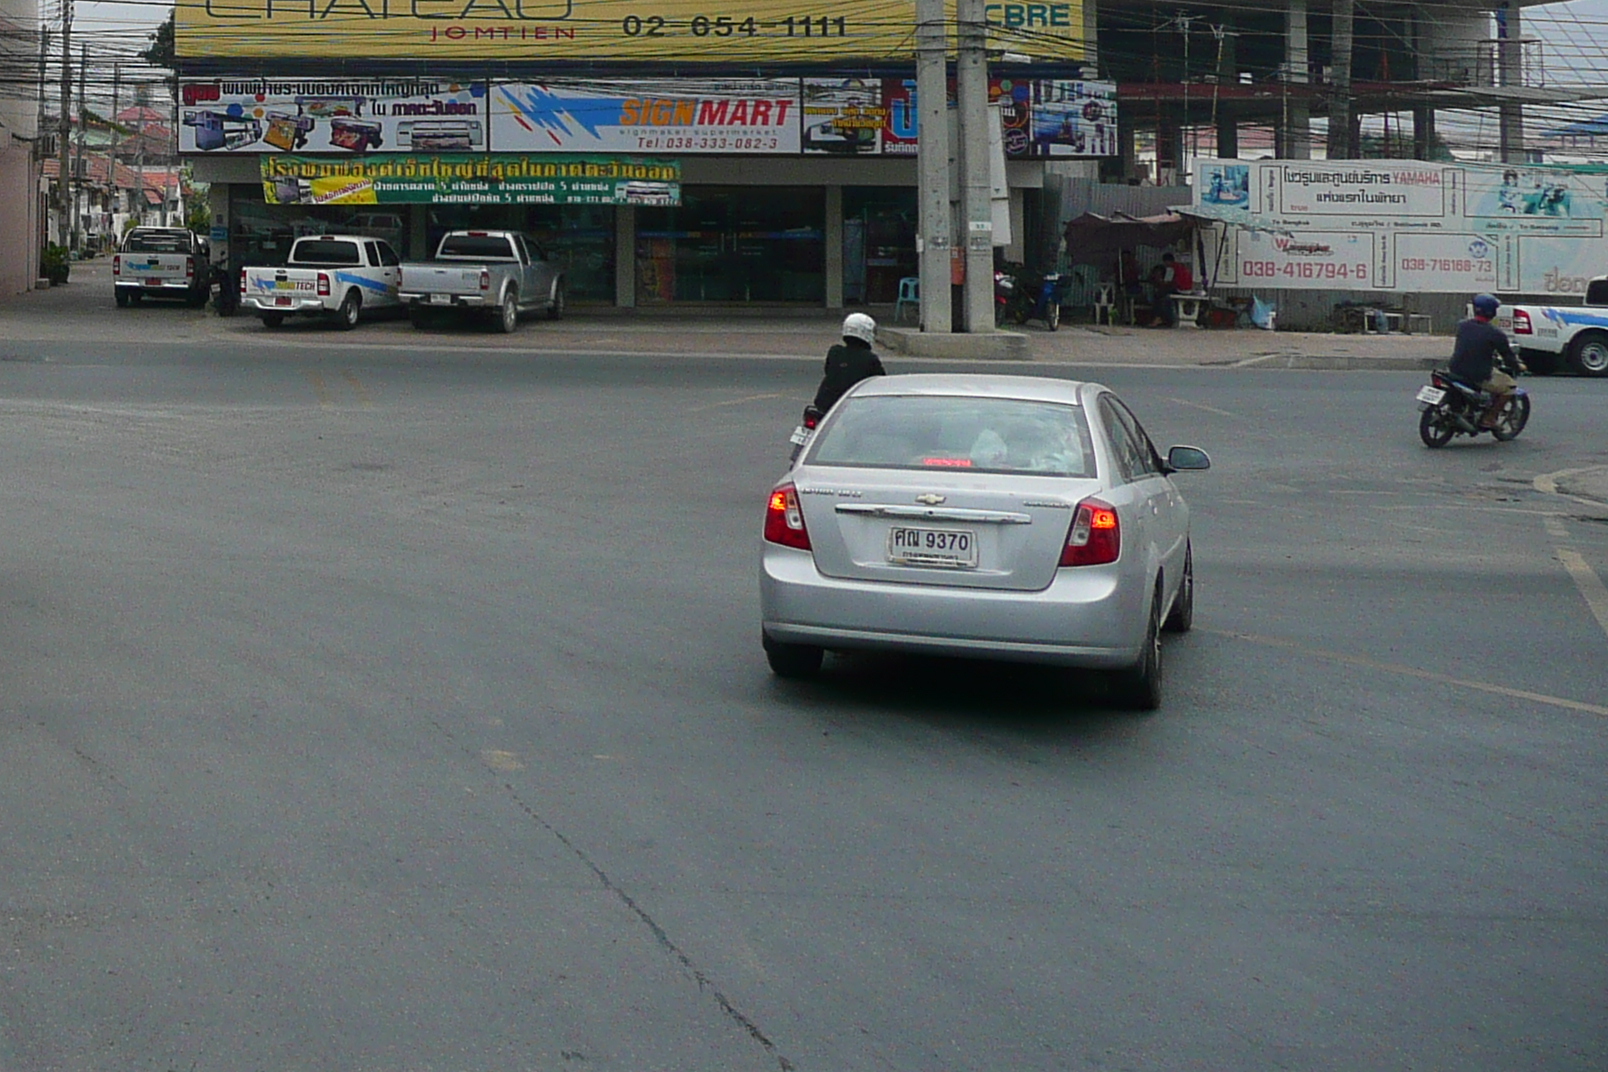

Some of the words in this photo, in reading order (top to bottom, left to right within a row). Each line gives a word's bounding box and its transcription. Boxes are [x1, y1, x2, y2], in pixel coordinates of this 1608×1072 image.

[985, 4, 1070, 26] CBRE
[429, 25, 576, 41] JOMTIEN
[622, 14, 848, 37] 02-654-1111
[1243, 260, 1367, 279] 038-416794-6
[925, 533, 969, 551] 9370
